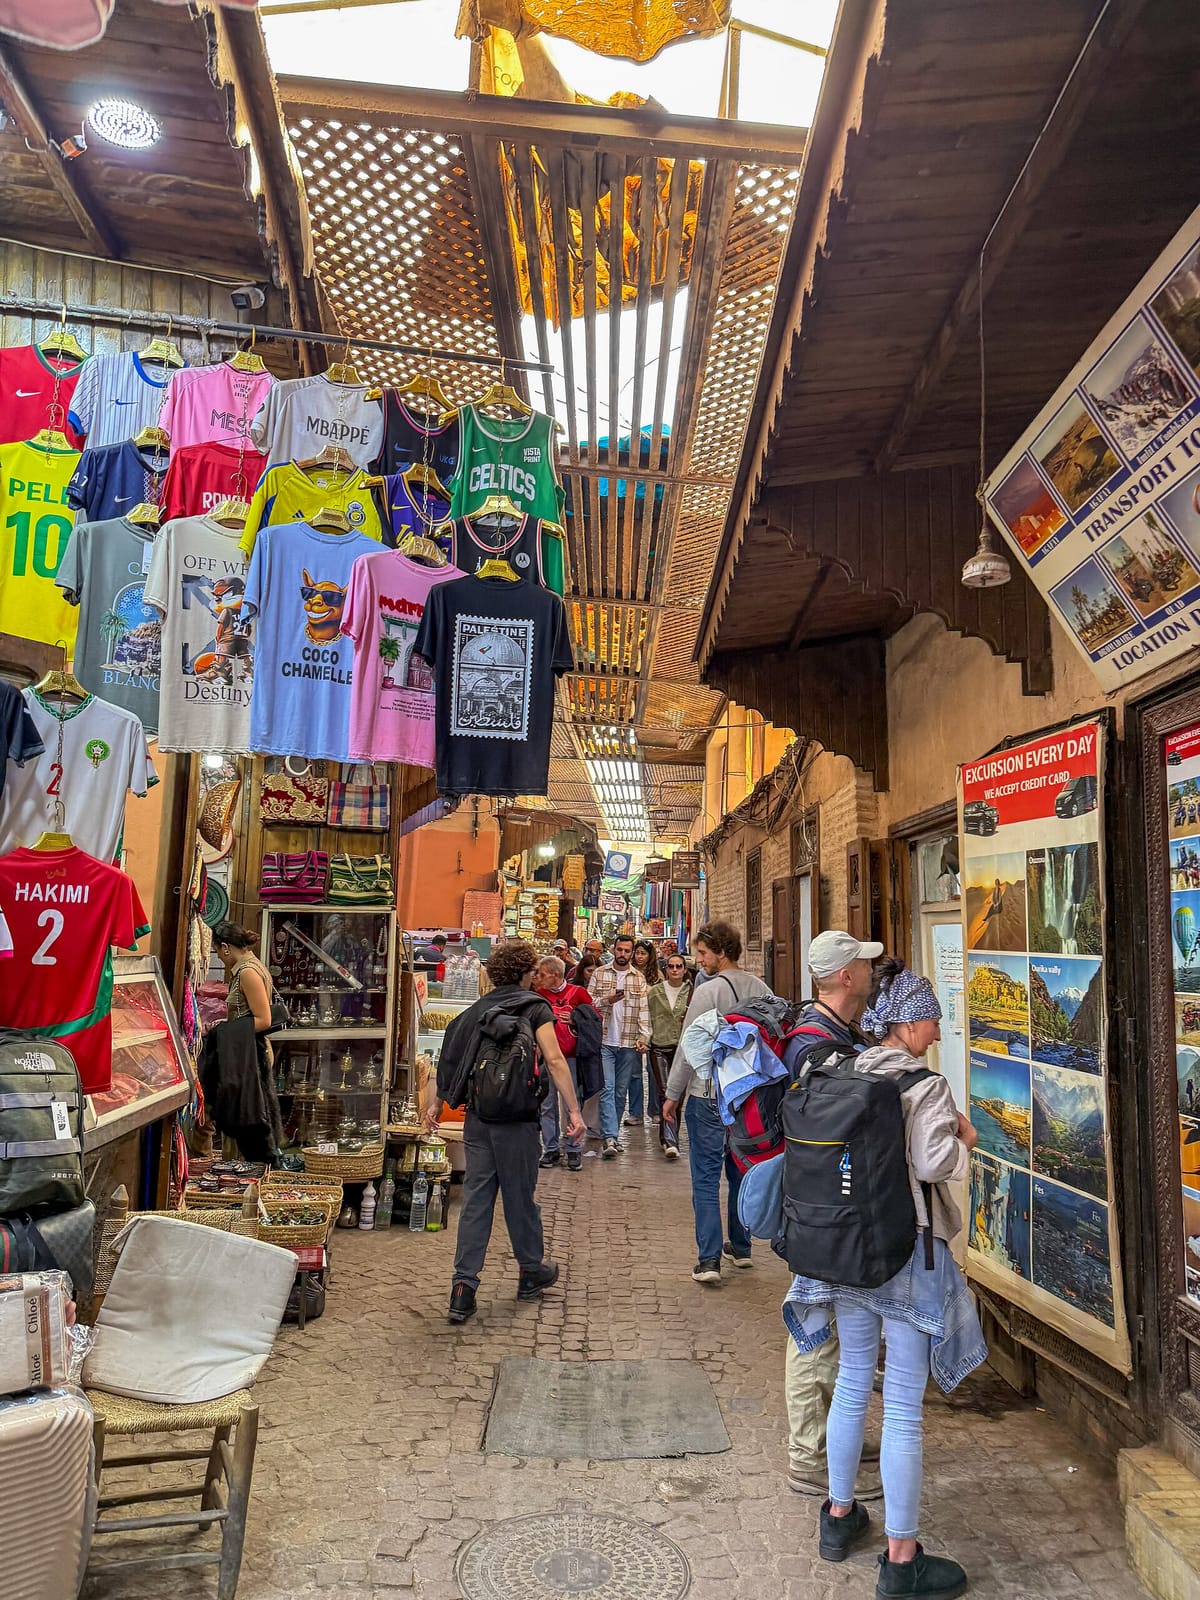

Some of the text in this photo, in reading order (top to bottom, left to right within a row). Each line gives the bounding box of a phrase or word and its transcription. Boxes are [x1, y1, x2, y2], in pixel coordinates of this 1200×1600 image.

[307, 415, 370, 445] MBAPPÉ
[523, 447, 541, 456] VISTA
[469, 463, 536, 501] CELTICS
[1081, 452, 1176, 543] TRANSPORT
[6, 511, 73, 577] 10
[184, 554, 217, 571] OFF
[462, 623, 527, 637] PALESTINE
[301, 646, 339, 665] COCO
[1112, 617, 1191, 671] LOCATION
[184, 681, 252, 708] Destiny
[965, 733, 1094, 785] EXCURSION EVERY DAY
[46, 763, 64, 796] 2
[984, 788, 995, 800] WE
[995, 782, 1020, 799] ACCEPT
[1020, 775, 1048, 792] CREDIT
[15, 882, 90, 904] HAKIMI
[31, 908, 65, 966] 2
[14, 1057, 41, 1065] NORTH
[23, 1063, 43, 1071] FACE
[25, 1051, 41, 1060] THE
[28, 1297, 39, 1334] Chloé
